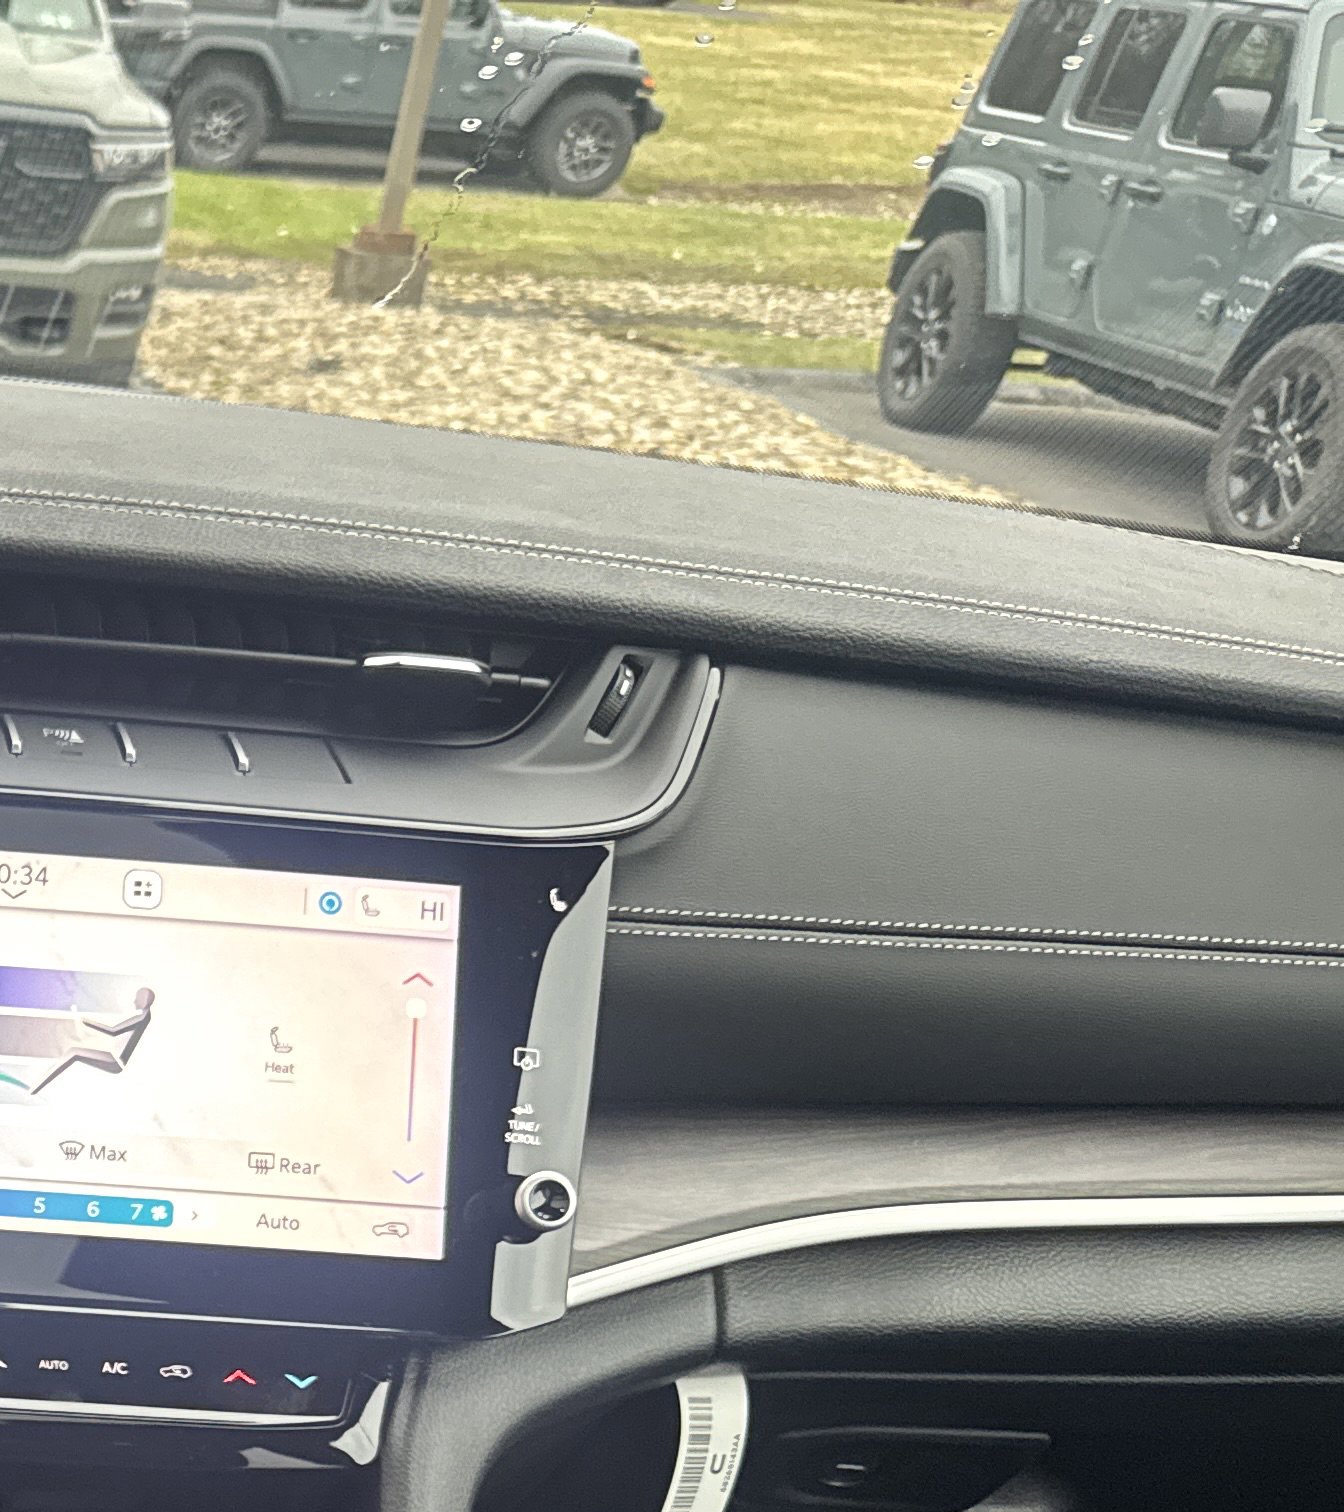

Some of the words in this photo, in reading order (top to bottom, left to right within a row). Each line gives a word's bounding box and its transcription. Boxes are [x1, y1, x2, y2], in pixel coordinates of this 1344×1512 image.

[420, 900, 445, 922] HI
[265, 1061, 295, 1075] Heat
[504, 1132, 541, 1146] SCROLL
[89, 1144, 128, 1163] Max
[279, 1157, 321, 1175] Rear
[33, 1197, 46, 1215] 5
[86, 1201, 100, 1218] 6
[130, 1203, 144, 1220] 7
[256, 1213, 300, 1231] Auto
[38, 1359, 69, 1371] AUTO
[101, 1362, 128, 1375] A/C
